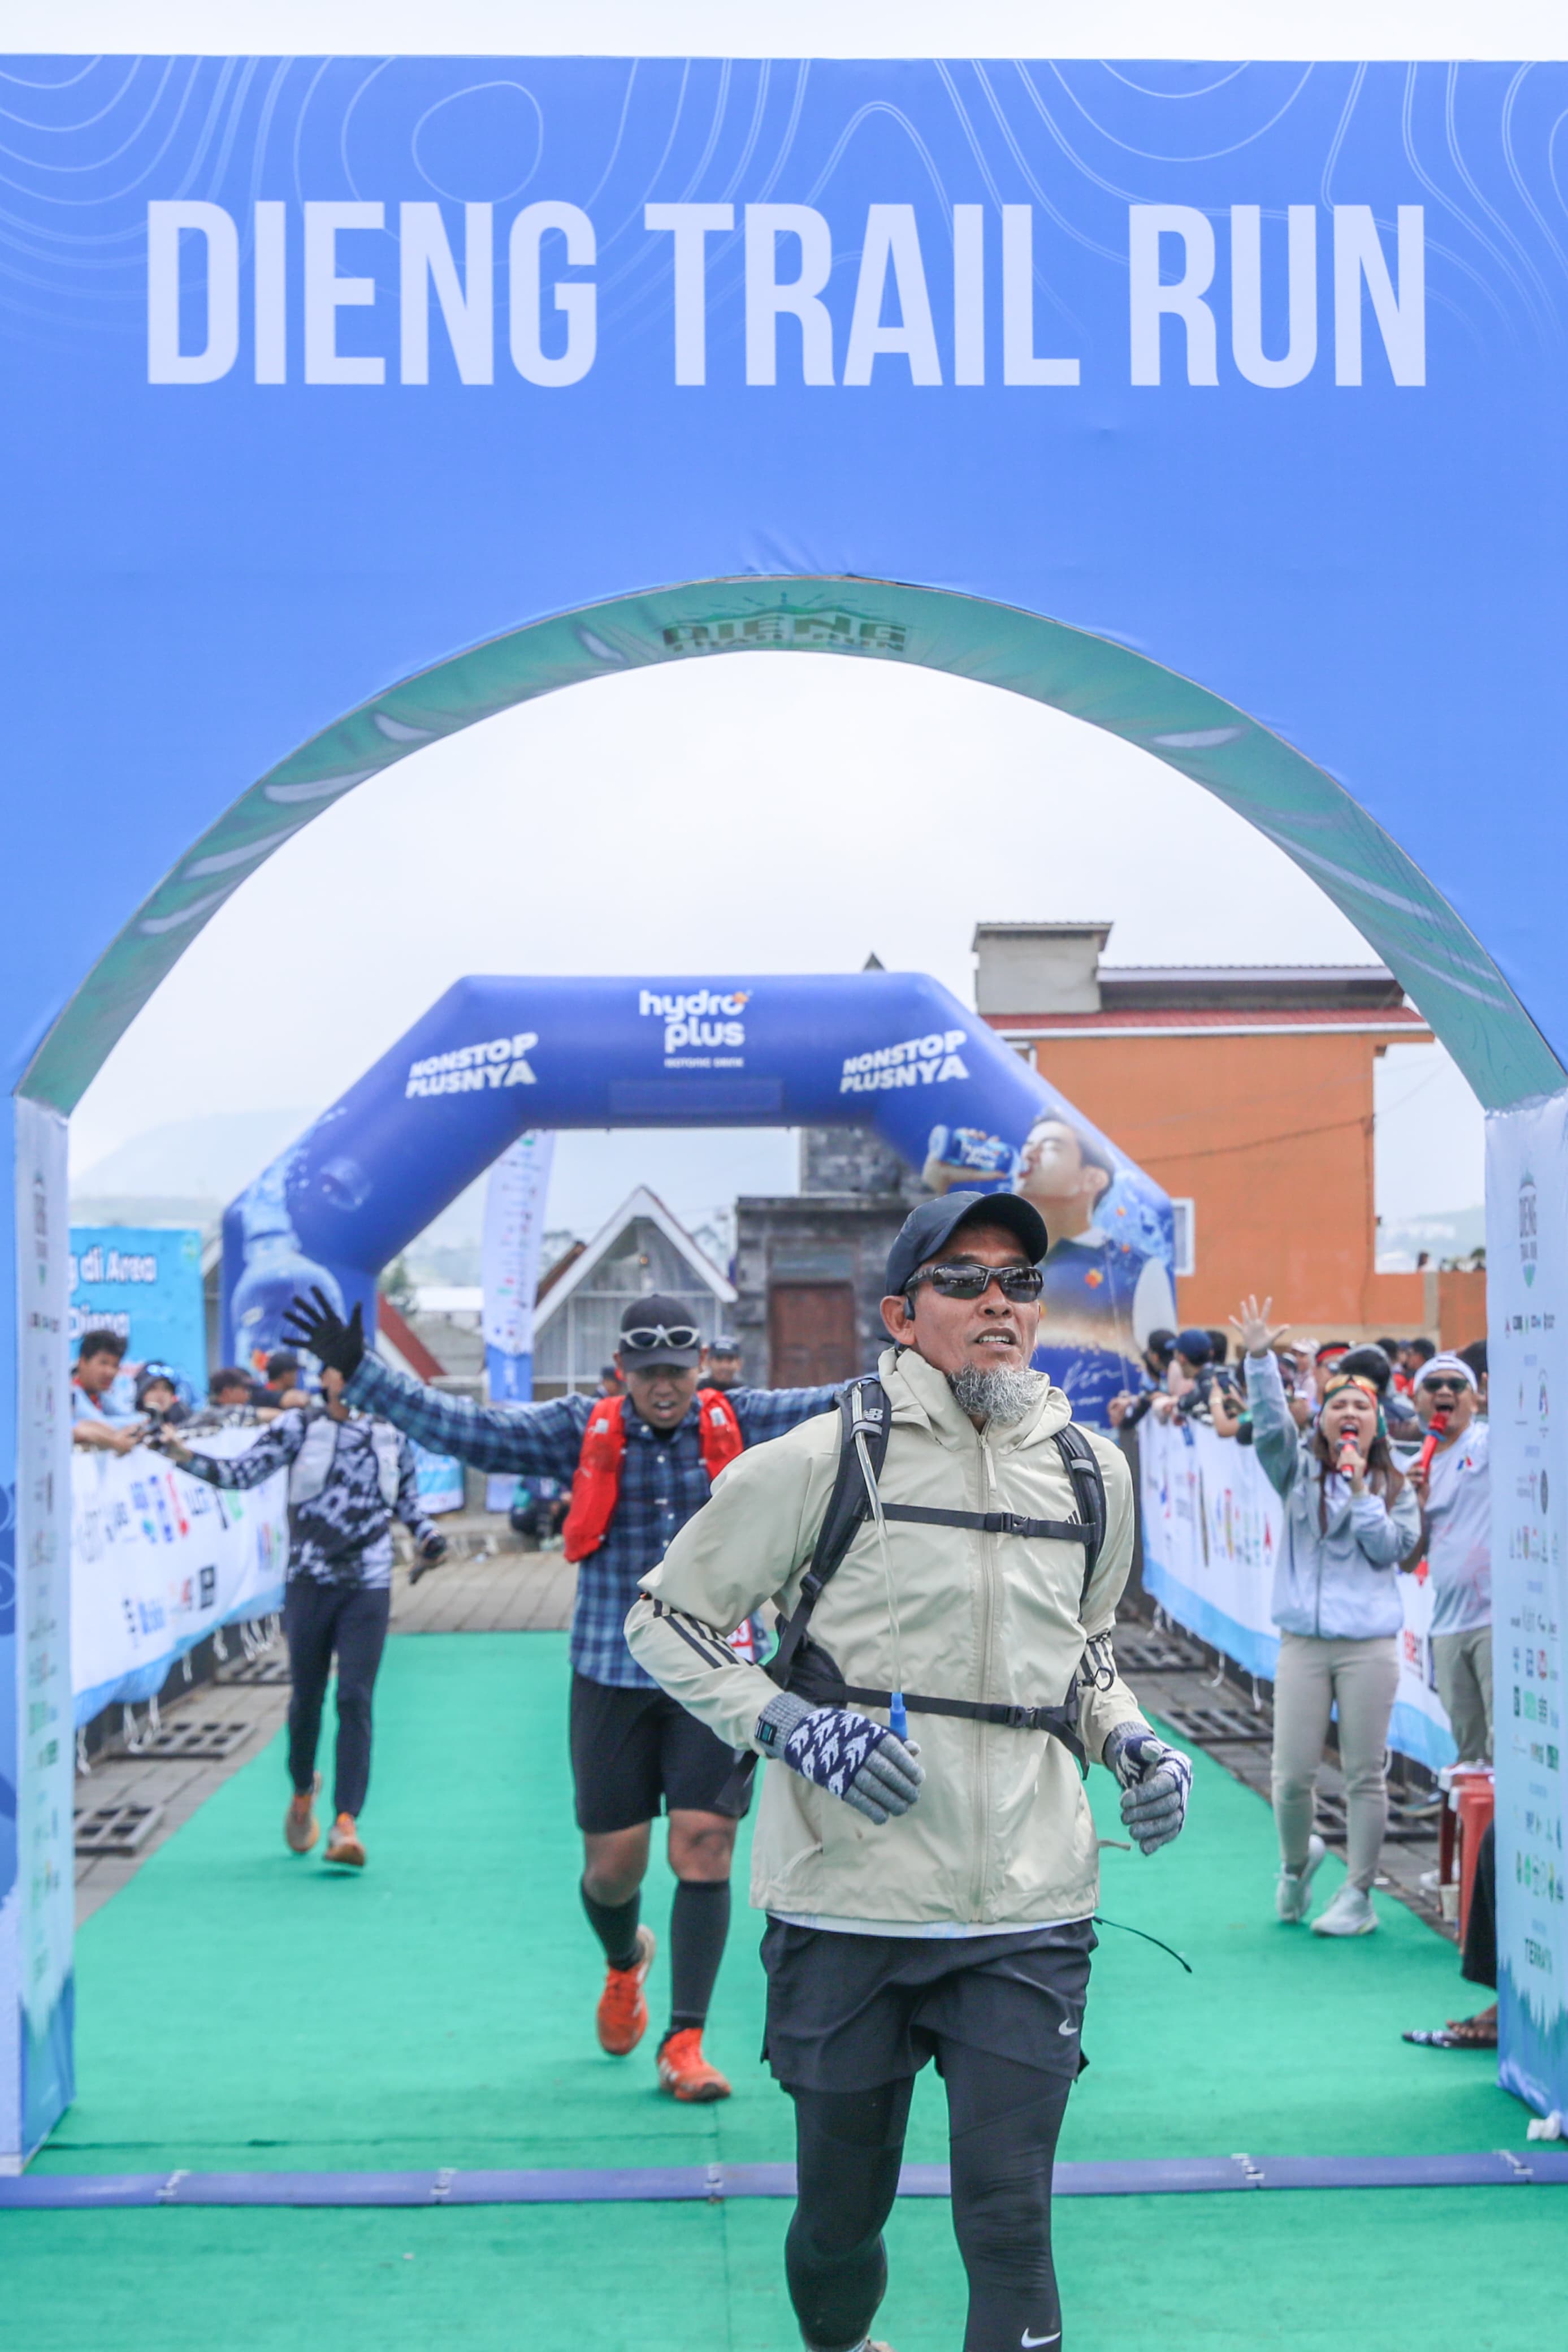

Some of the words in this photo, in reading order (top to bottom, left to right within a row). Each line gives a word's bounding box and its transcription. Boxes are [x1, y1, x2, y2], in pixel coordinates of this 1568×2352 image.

[148, 200, 596, 387] DIENG
[644, 203, 1080, 386] TRAIL
[1129, 205, 1426, 388] RUN
[639, 989, 746, 1024] hydro
[664, 1016, 746, 1054] plus
[843, 1029, 968, 1075] NONSTOP
[409, 1031, 539, 1079] NONSTOP
[839, 1054, 969, 1093] PLUSNYA
[405, 1059, 537, 1099] PLUSNYA
[80, 1245, 105, 1283] di
